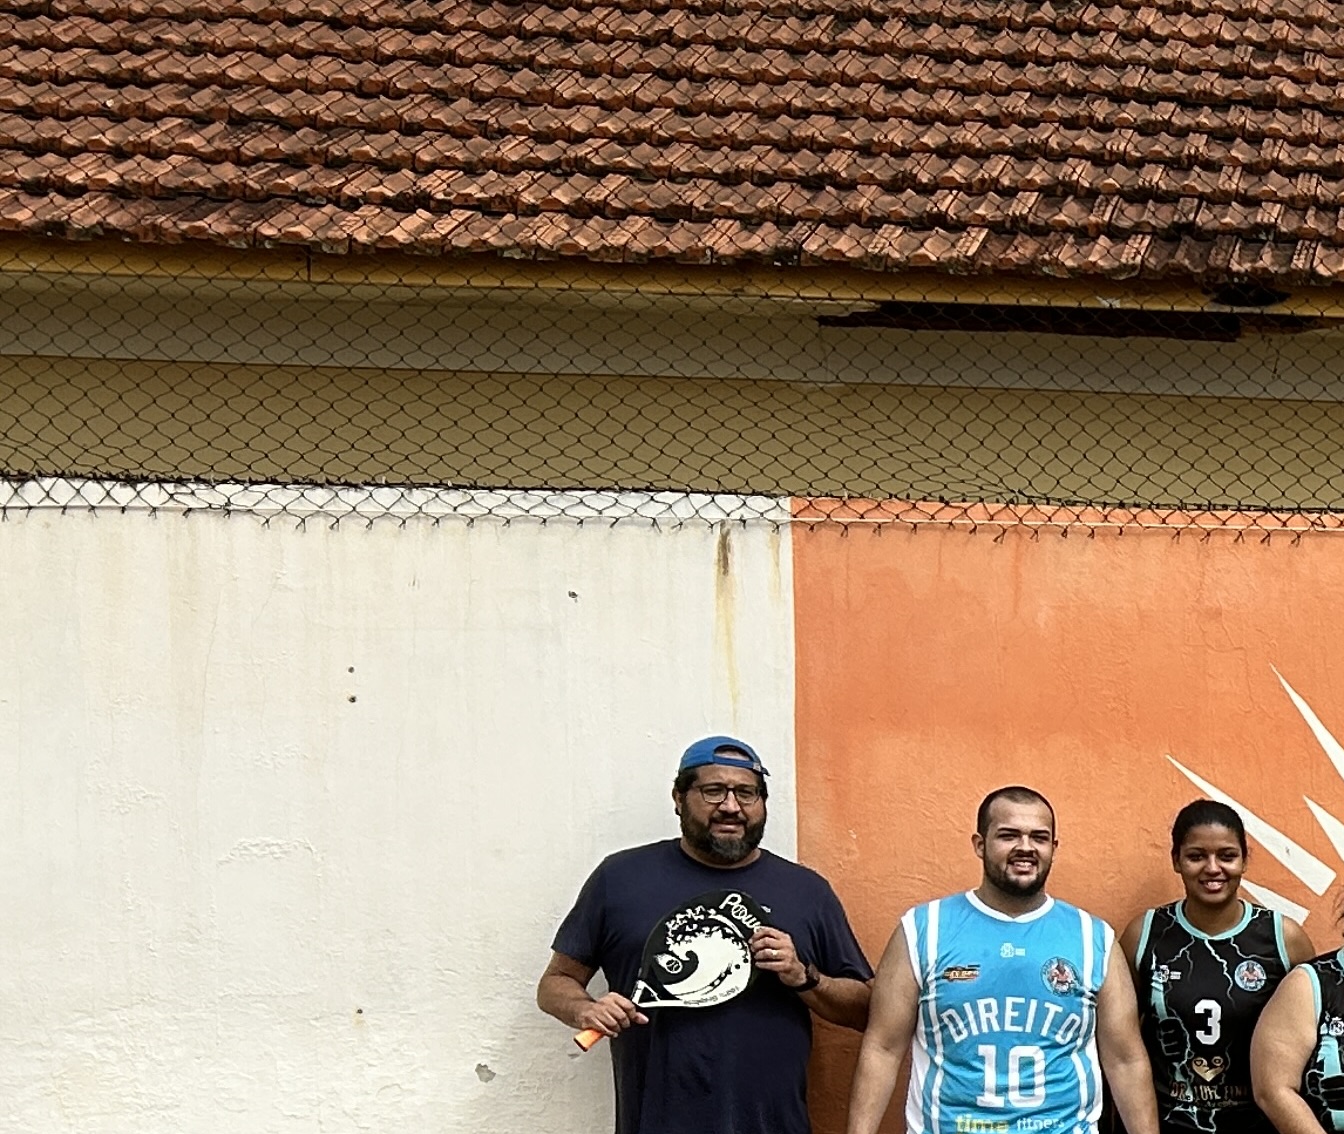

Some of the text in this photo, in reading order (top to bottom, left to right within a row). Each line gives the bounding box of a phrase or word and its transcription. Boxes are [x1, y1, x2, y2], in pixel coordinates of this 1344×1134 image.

[940, 996, 1082, 1045] DIREITO
[1194, 998, 1222, 1045] 3
[976, 1044, 1047, 1108] 10
